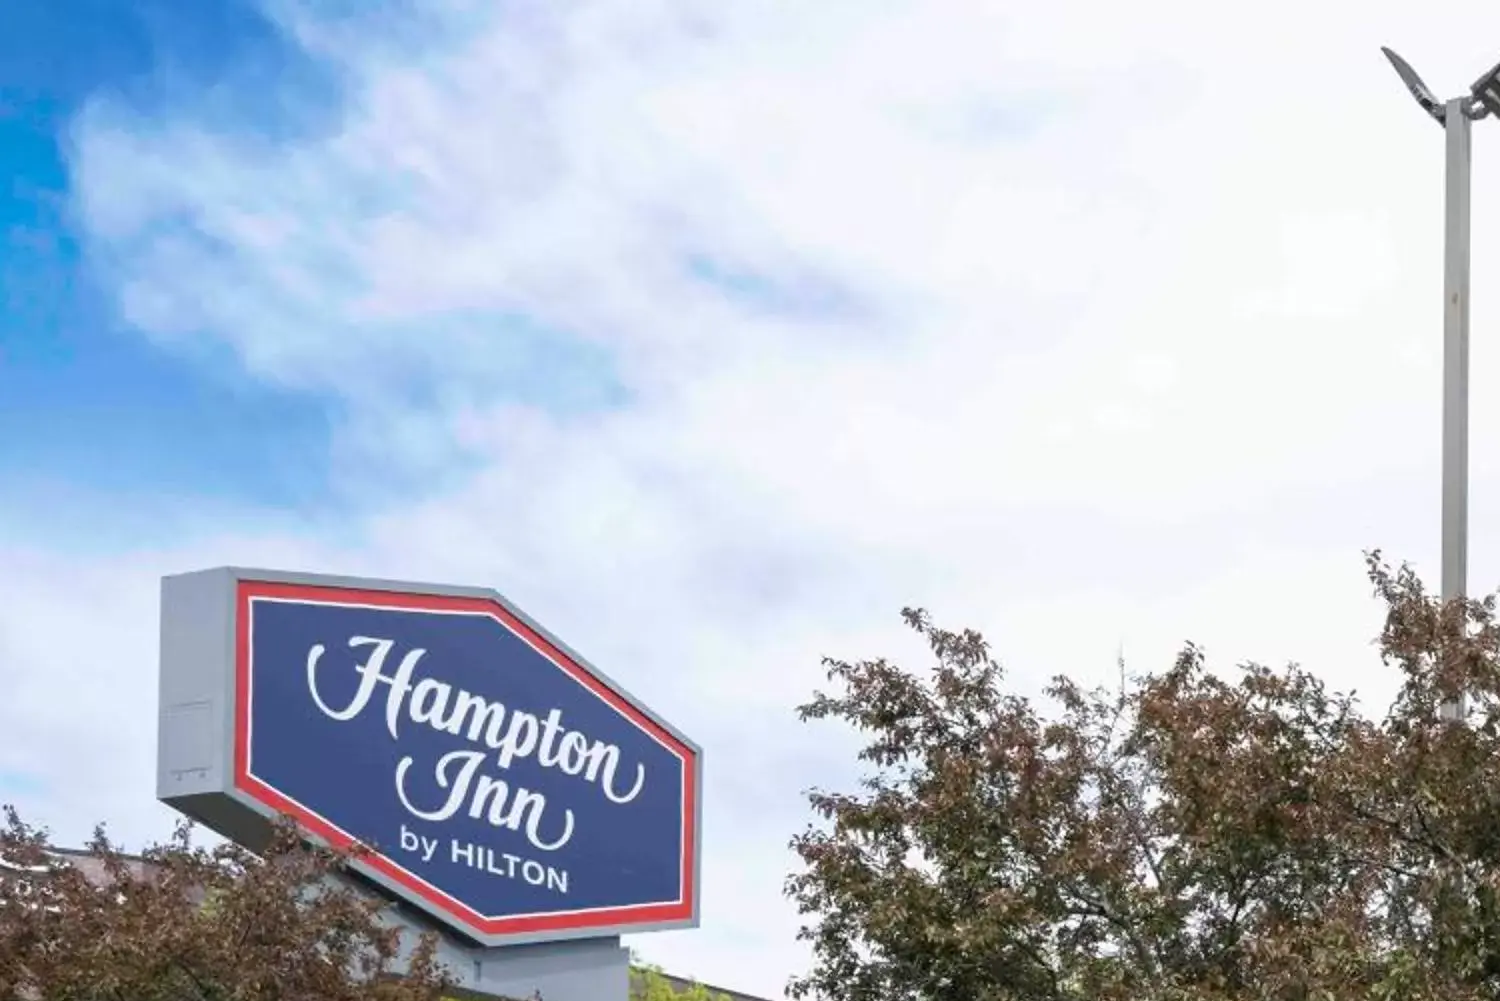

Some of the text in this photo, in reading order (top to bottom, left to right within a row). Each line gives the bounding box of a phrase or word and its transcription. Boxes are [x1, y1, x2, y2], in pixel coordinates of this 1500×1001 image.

[307, 635, 645, 803] Hampton
[396, 750, 575, 851] Inn
[400, 823, 569, 894] by HILTON
